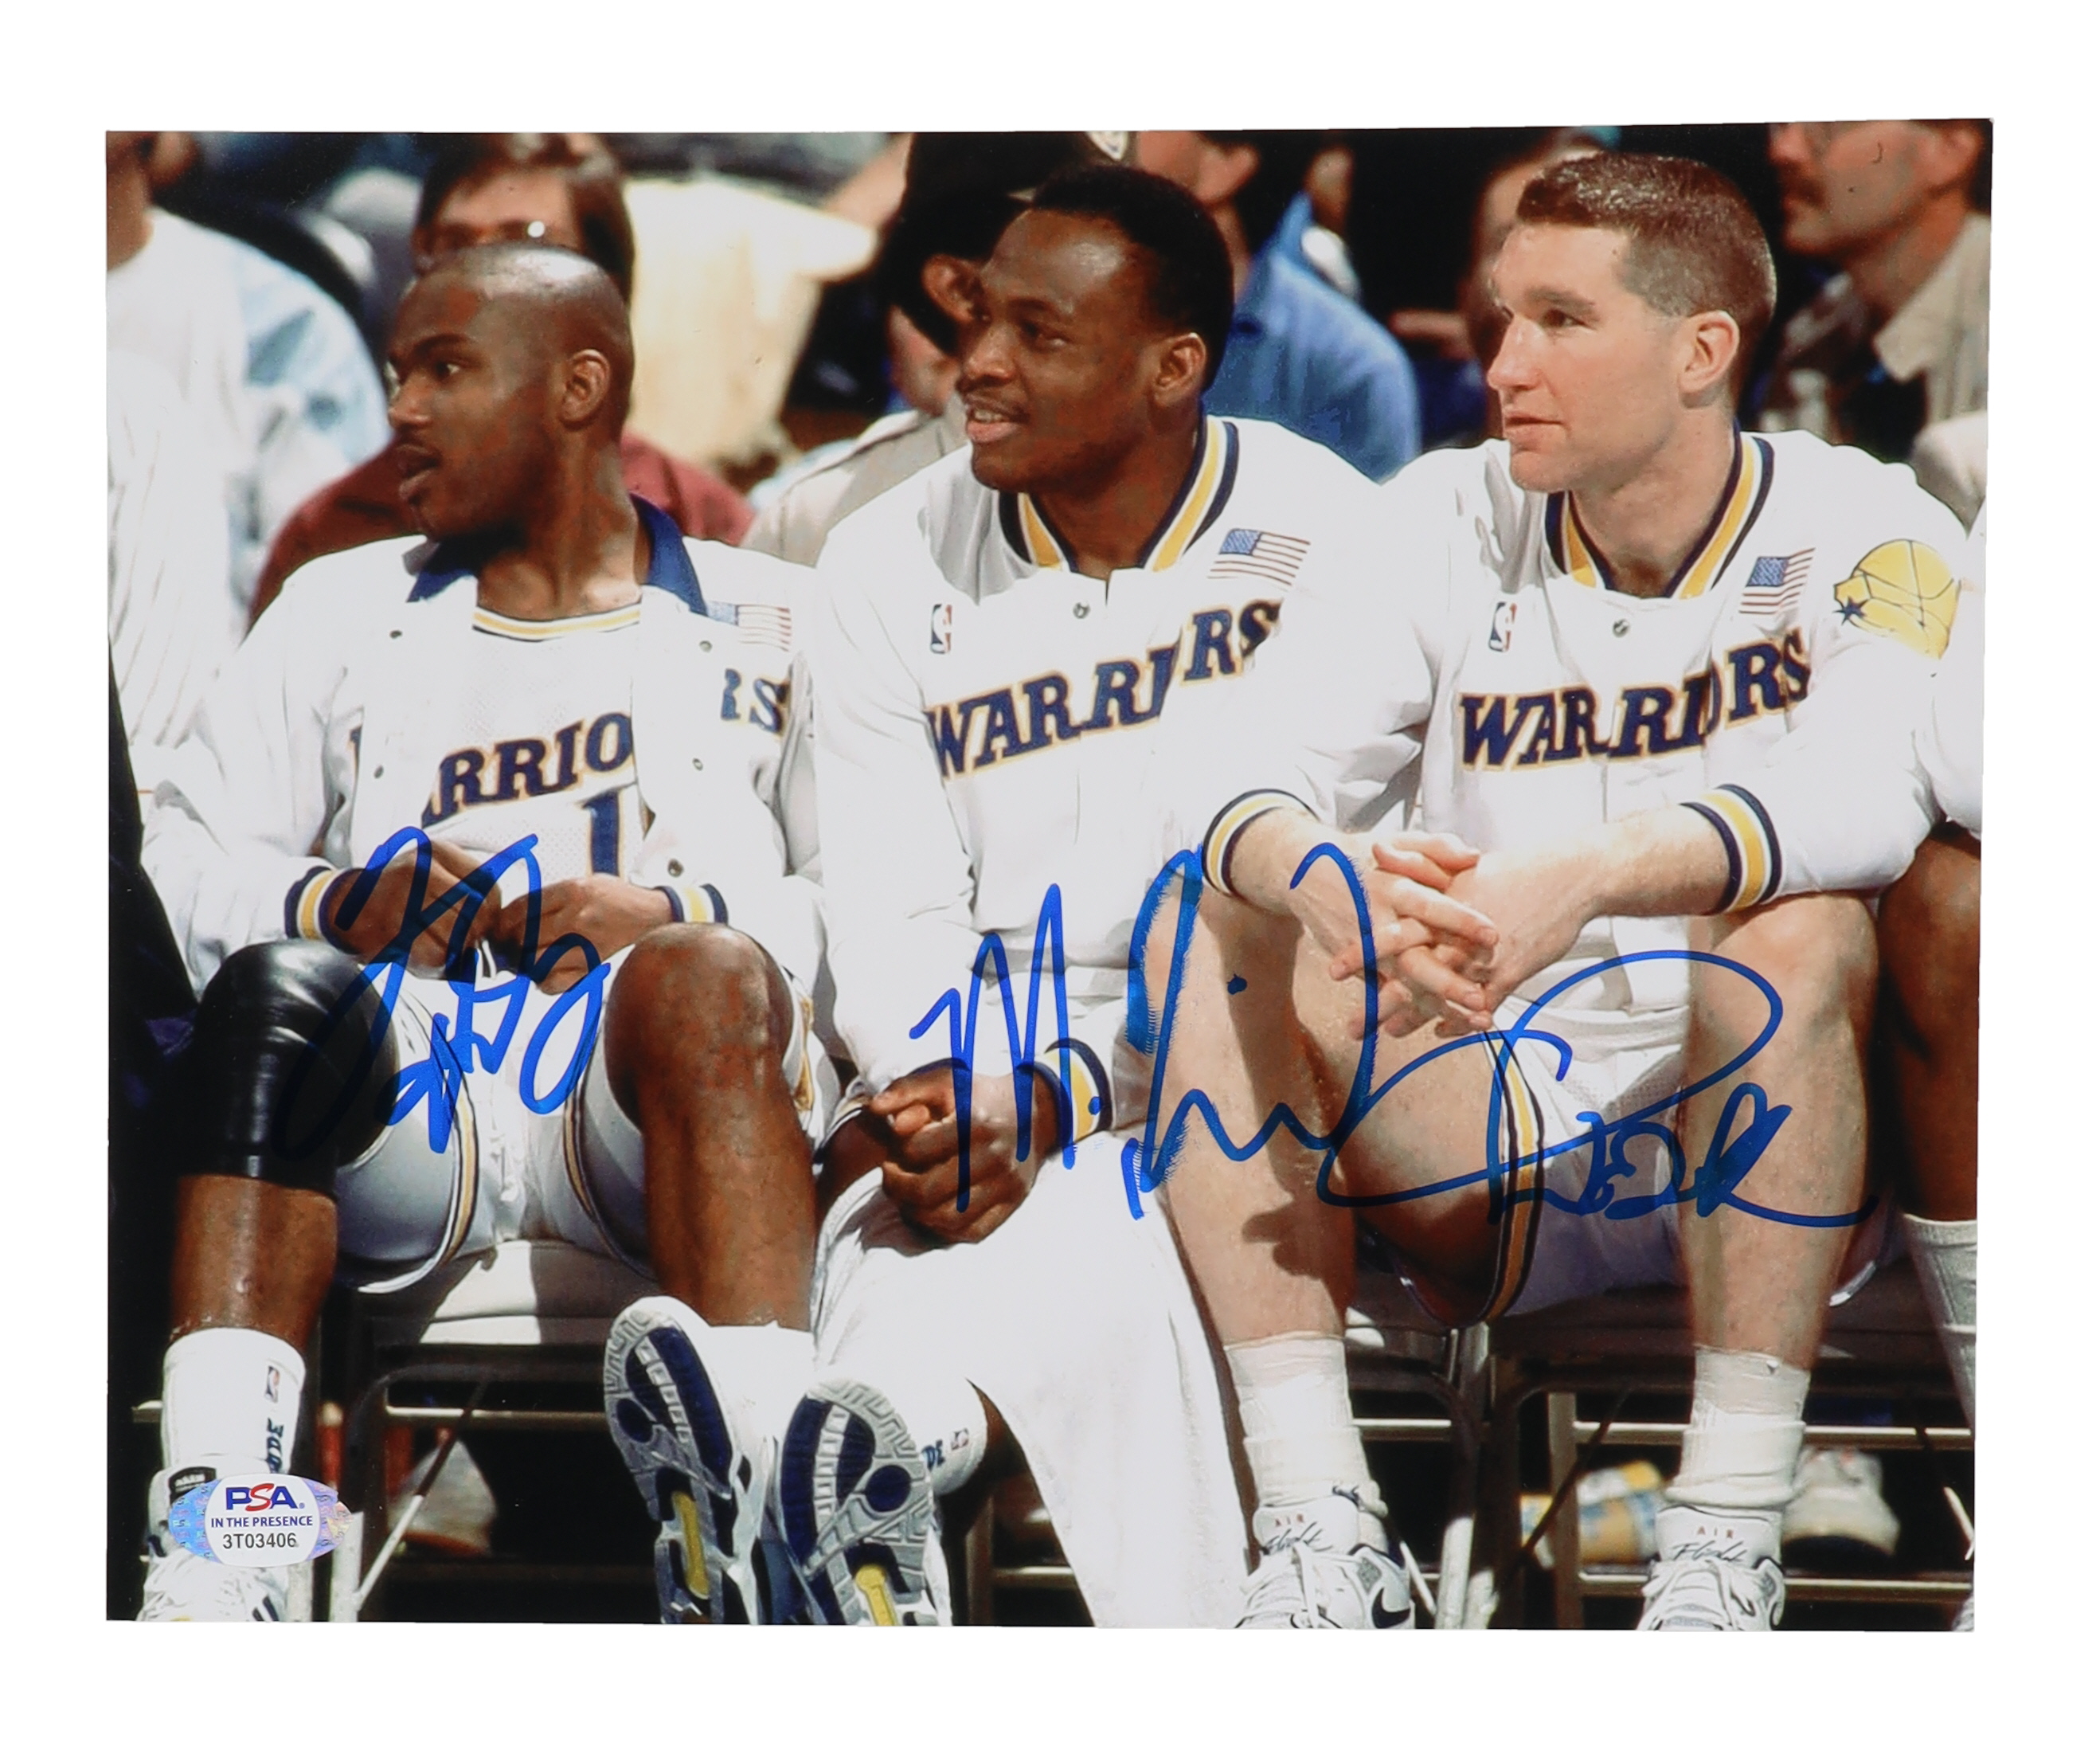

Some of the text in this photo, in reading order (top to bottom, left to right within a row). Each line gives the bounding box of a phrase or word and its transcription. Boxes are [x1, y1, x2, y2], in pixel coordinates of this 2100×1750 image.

[924, 599, 1283, 780] WARRIRS
[225, 1483, 299, 1512] PSA
[211, 1516, 313, 1528] IN THE PRESENCE
[223, 1533, 298, 1549] 3T03406
